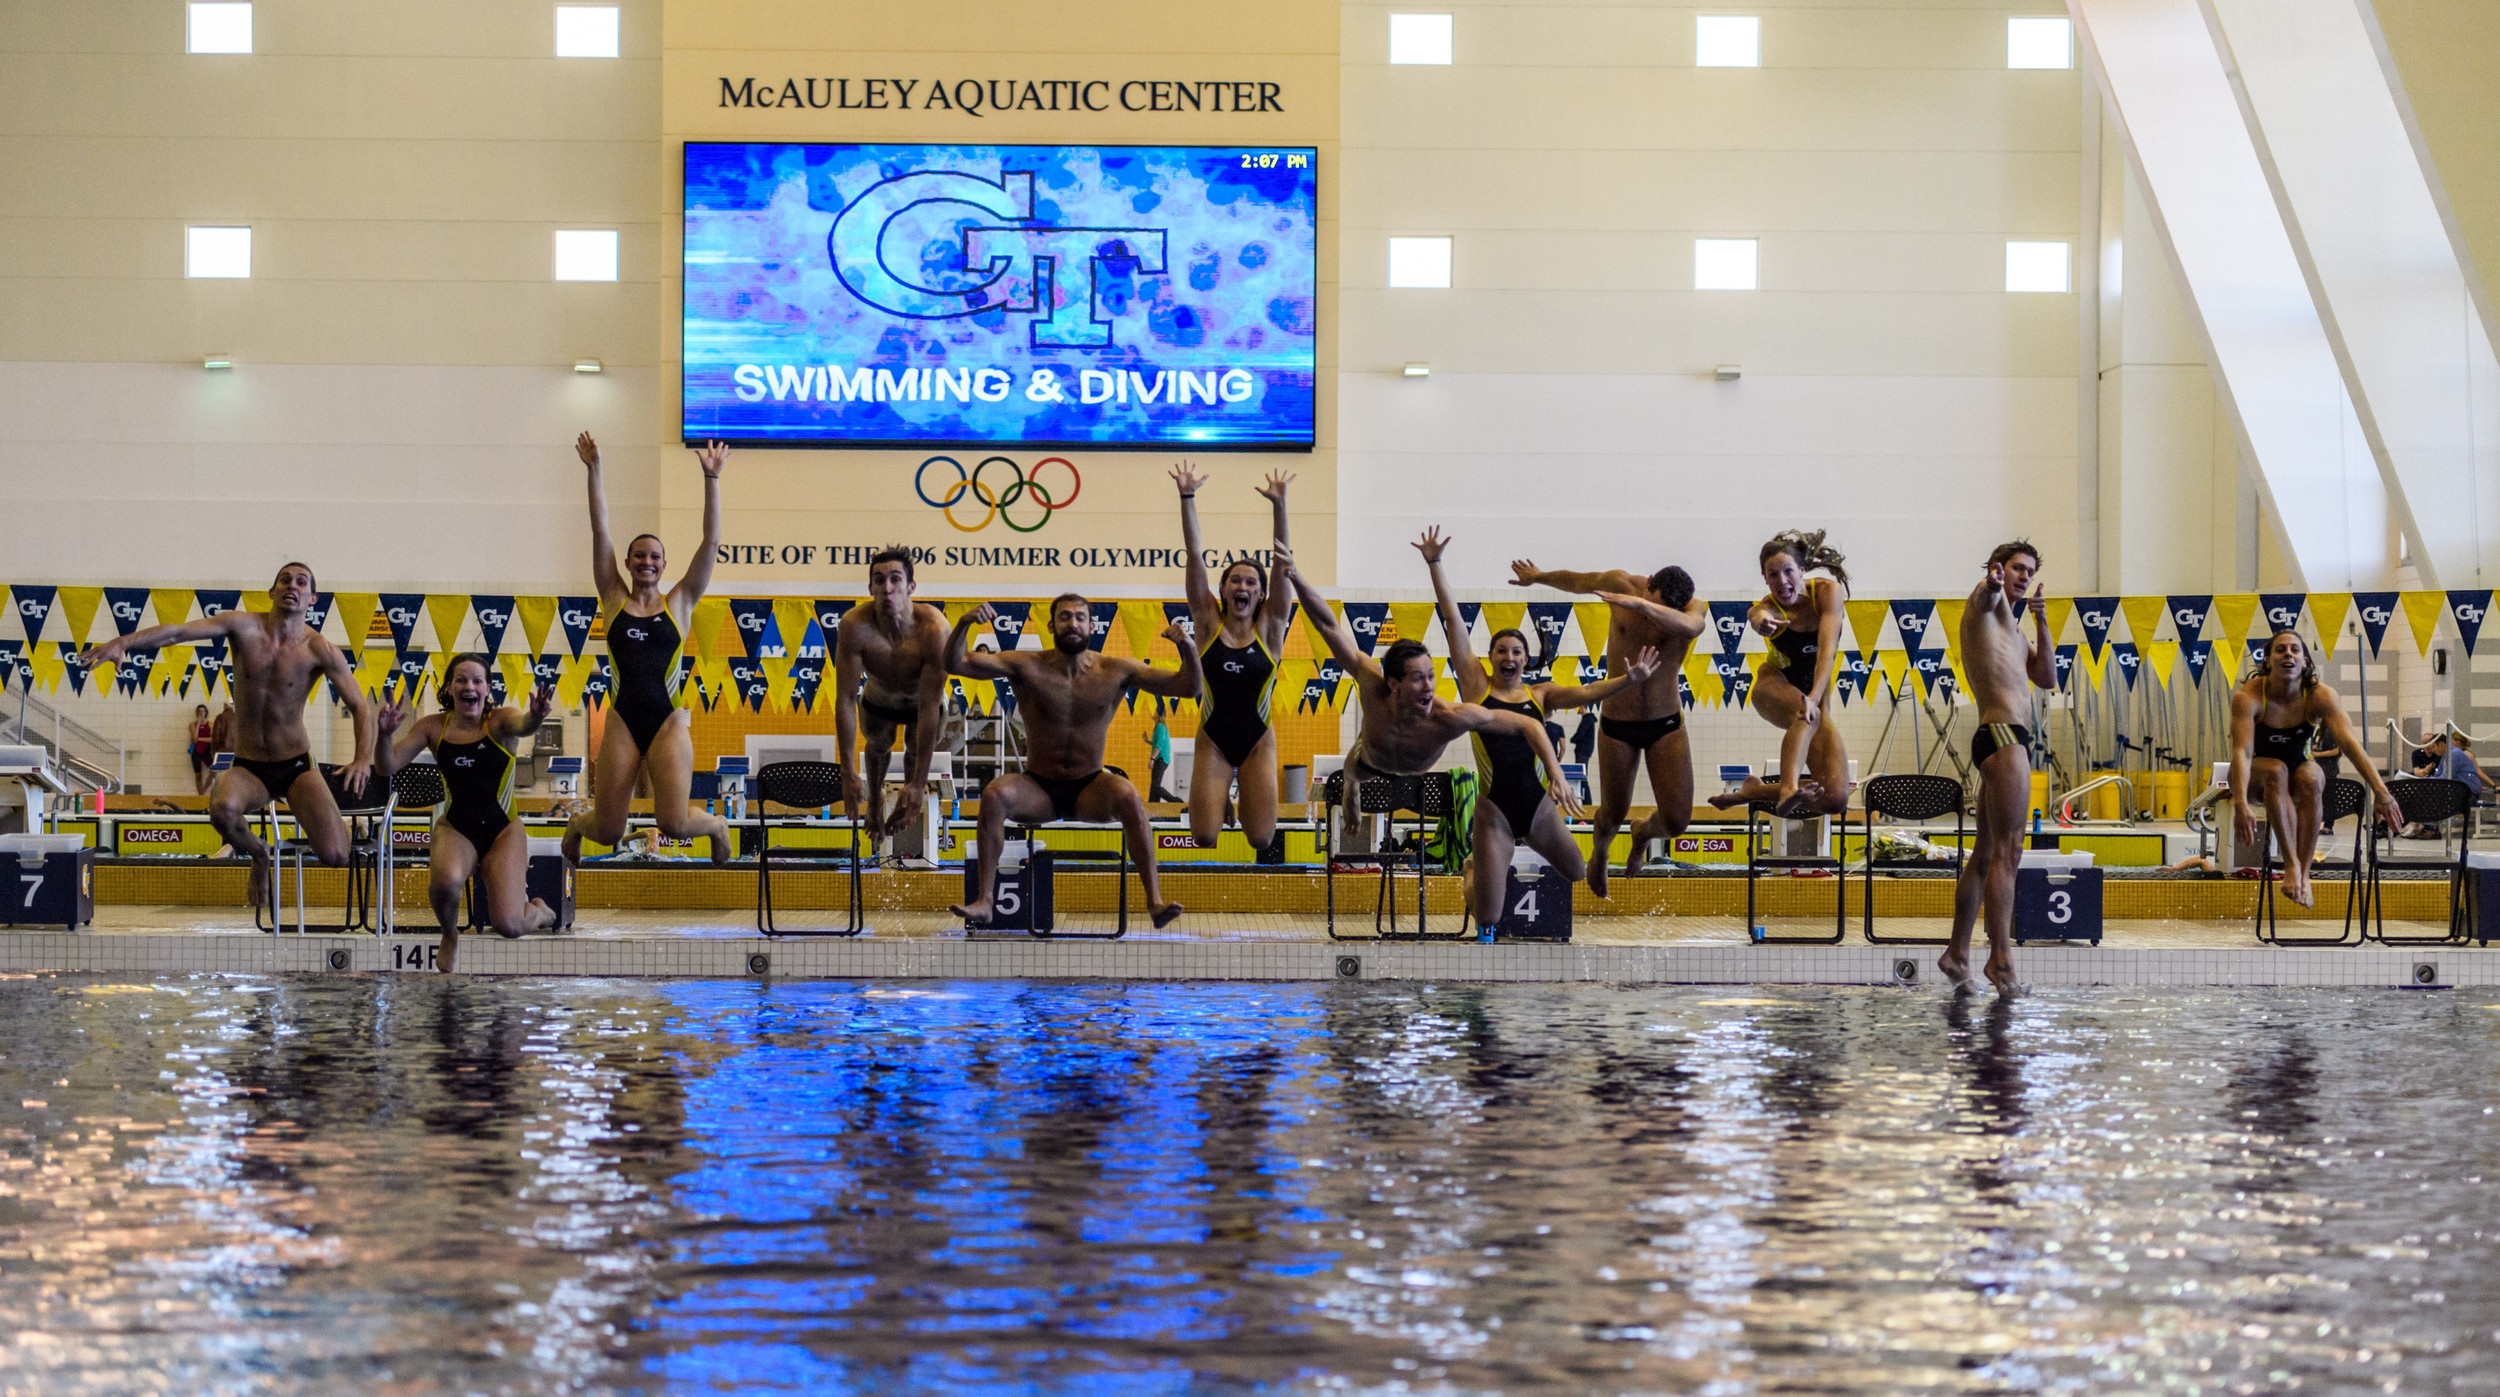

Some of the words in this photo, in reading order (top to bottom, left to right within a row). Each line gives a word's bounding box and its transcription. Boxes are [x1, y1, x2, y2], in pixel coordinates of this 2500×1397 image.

[717, 77, 919, 109] McAULEY
[923, 79, 1110, 117] AQUATIC
[1119, 80, 1285, 112] CENTER
[1241, 153, 1280, 169] 2:07
[1287, 153, 1308, 169] PM
[827, 170, 1168, 349] GT
[732, 364, 1011, 403] SWIMMING
[1025, 367, 1065, 404] &
[1079, 368, 1254, 406] DIVING
[716, 544, 776, 565] SITE
[781, 545, 817, 565] OF
[944, 547, 1062, 567] SUMMER
[1069, 548, 1187, 568] OLYMPIC
[1202, 549, 1292, 569] GAME
[19, 599, 47, 619] GT
[112, 601, 141, 621] GT
[387, 607, 416, 627] GT
[479, 609, 507, 628] GT
[562, 609, 592, 629] GT
[2175, 608, 2204, 628] GT
[2268, 606, 2297, 626] GT
[2361, 605, 2391, 625] GT
[2455, 603, 2484, 623] GT
[738, 612, 766, 632] GT
[994, 615, 1023, 635] GT
[1352, 616, 1381, 636] GT
[1716, 615, 1745, 636] GT
[1898, 613, 1927, 632] GT
[2082, 610, 2111, 630] GT
[627, 628, 648, 641] GT
[133, 654, 154, 669] GT
[201, 656, 222, 671] GT
[402, 661, 423, 675] GT
[1223, 661, 1244, 674] GT
[1718, 663, 1740, 677] GT
[1917, 658, 1939, 673] GT
[2118, 653, 2140, 667] GT
[534, 663, 556, 678] GT
[733, 667, 755, 681] GT
[799, 667, 821, 682] GT
[1320, 668, 1341, 683] GT
[454, 756, 475, 768] GT
[127, 829, 179, 842] OMEGA
[392, 831, 431, 844] OMEG
[656, 836, 693, 847] MEGA
[1679, 839, 1729, 851] OMEGA
[20, 875, 44, 908] 7
[995, 882, 1022, 916] 5
[1513, 890, 1540, 922] 4
[2047, 891, 2073, 924] 3
